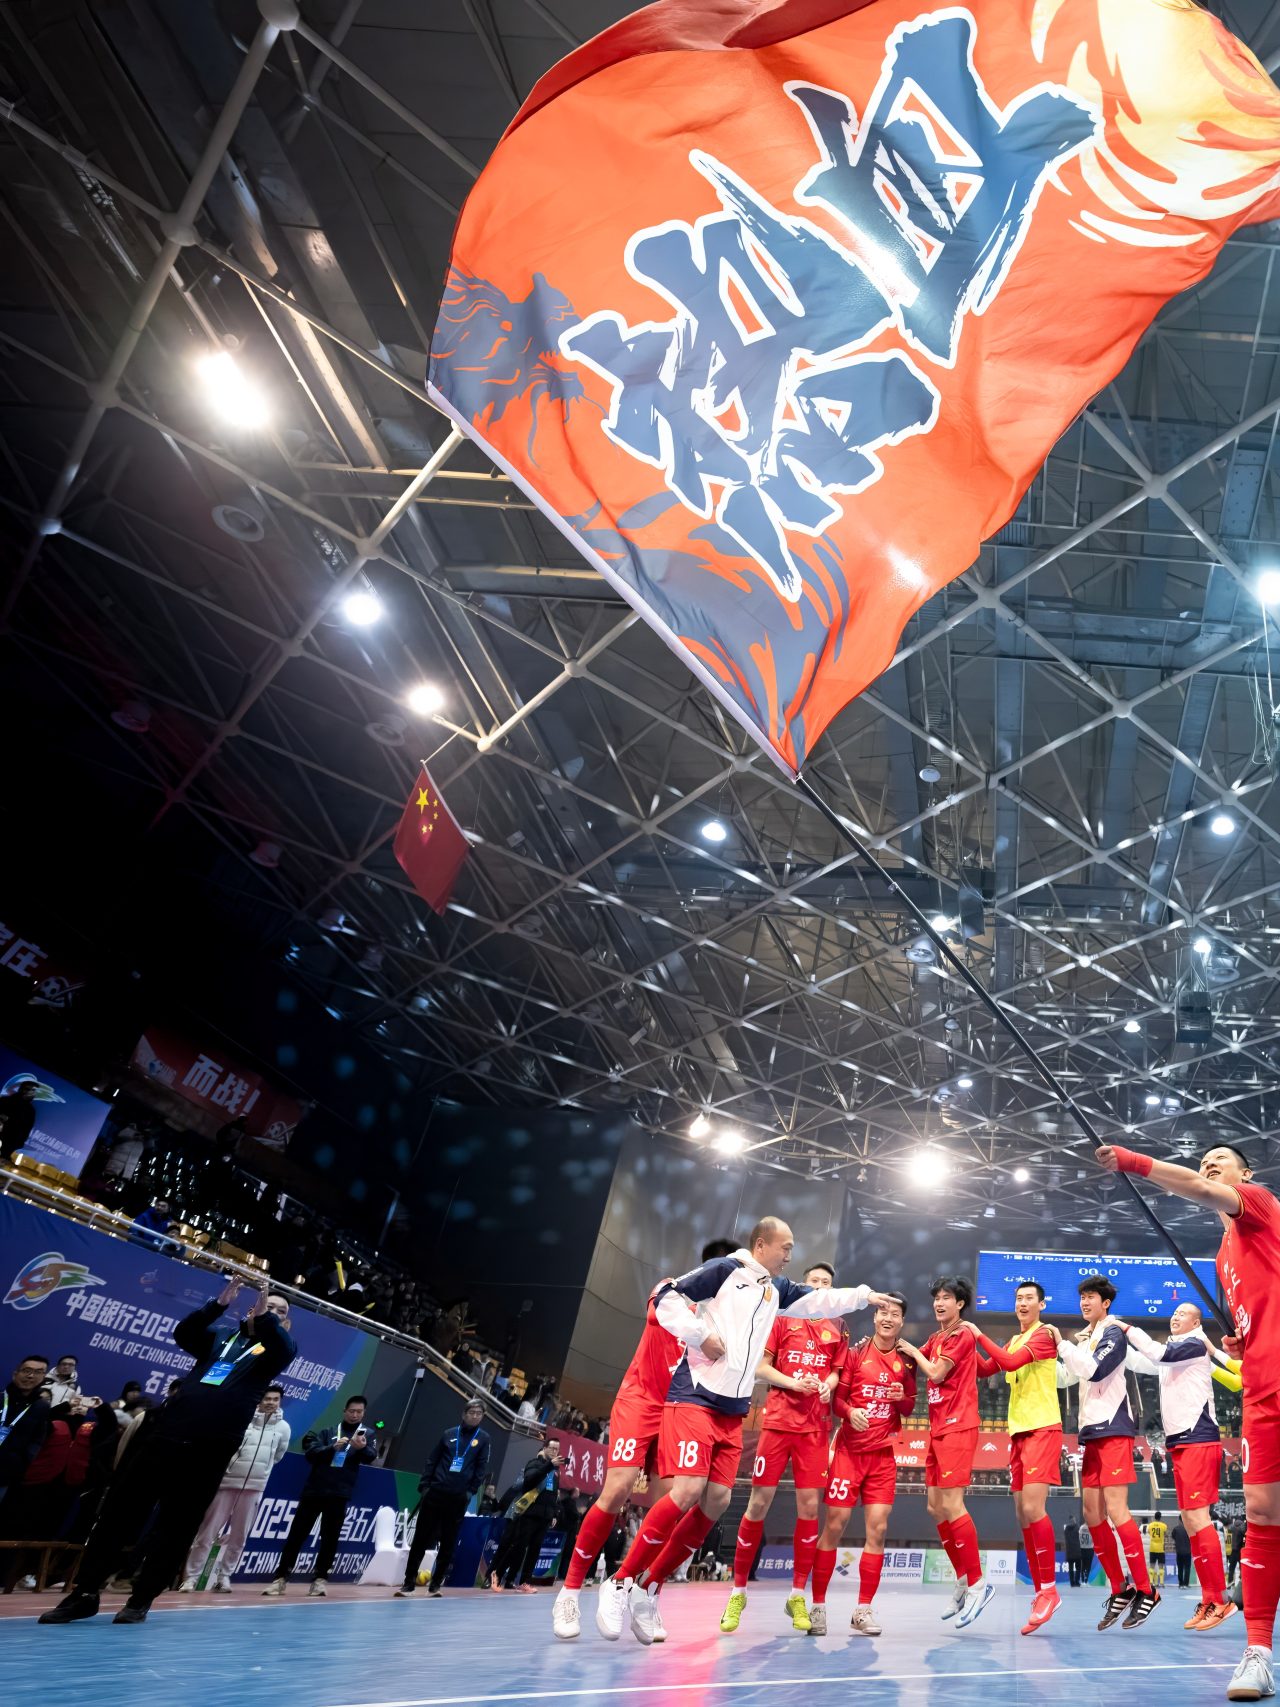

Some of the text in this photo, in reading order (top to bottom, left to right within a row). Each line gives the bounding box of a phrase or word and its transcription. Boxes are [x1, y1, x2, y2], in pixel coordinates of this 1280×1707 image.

[558, 7, 1105, 601] 热血
[89, 1332, 126, 1353] BANK
[787, 1350, 828, 1367] 石家庄
[878, 1372, 888, 1383] 55
[612, 1437, 637, 1462] 88
[677, 1440, 699, 1468] 18
[828, 1477, 851, 1501] 55
[1152, 1527, 1161, 1538] 24
